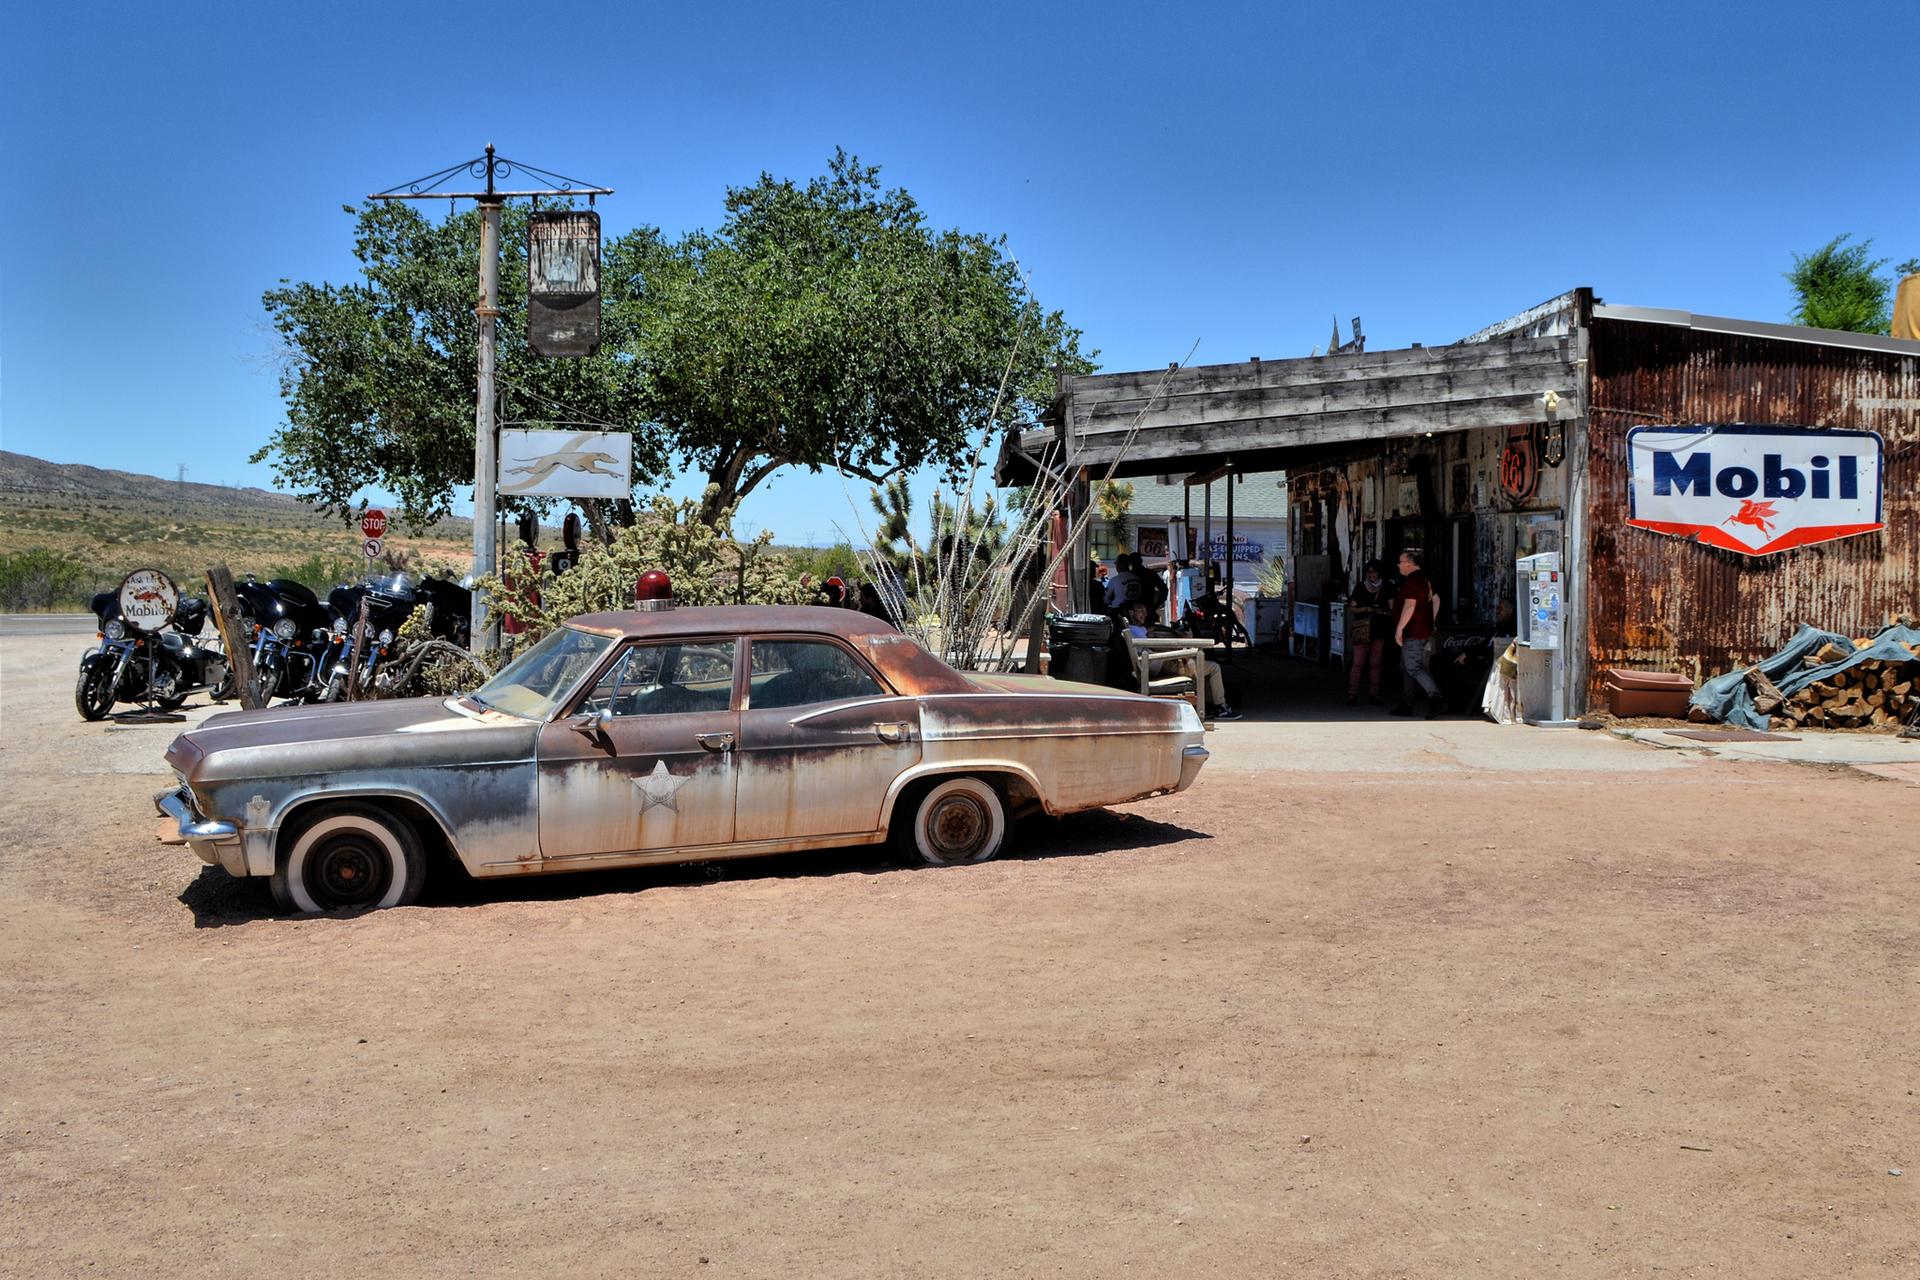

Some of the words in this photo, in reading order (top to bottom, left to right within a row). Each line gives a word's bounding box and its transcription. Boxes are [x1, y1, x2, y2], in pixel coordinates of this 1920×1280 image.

[1653, 451, 1858, 499] Mobil
[363, 518, 385, 530] STOP
[1144, 541, 1162, 556] 66
